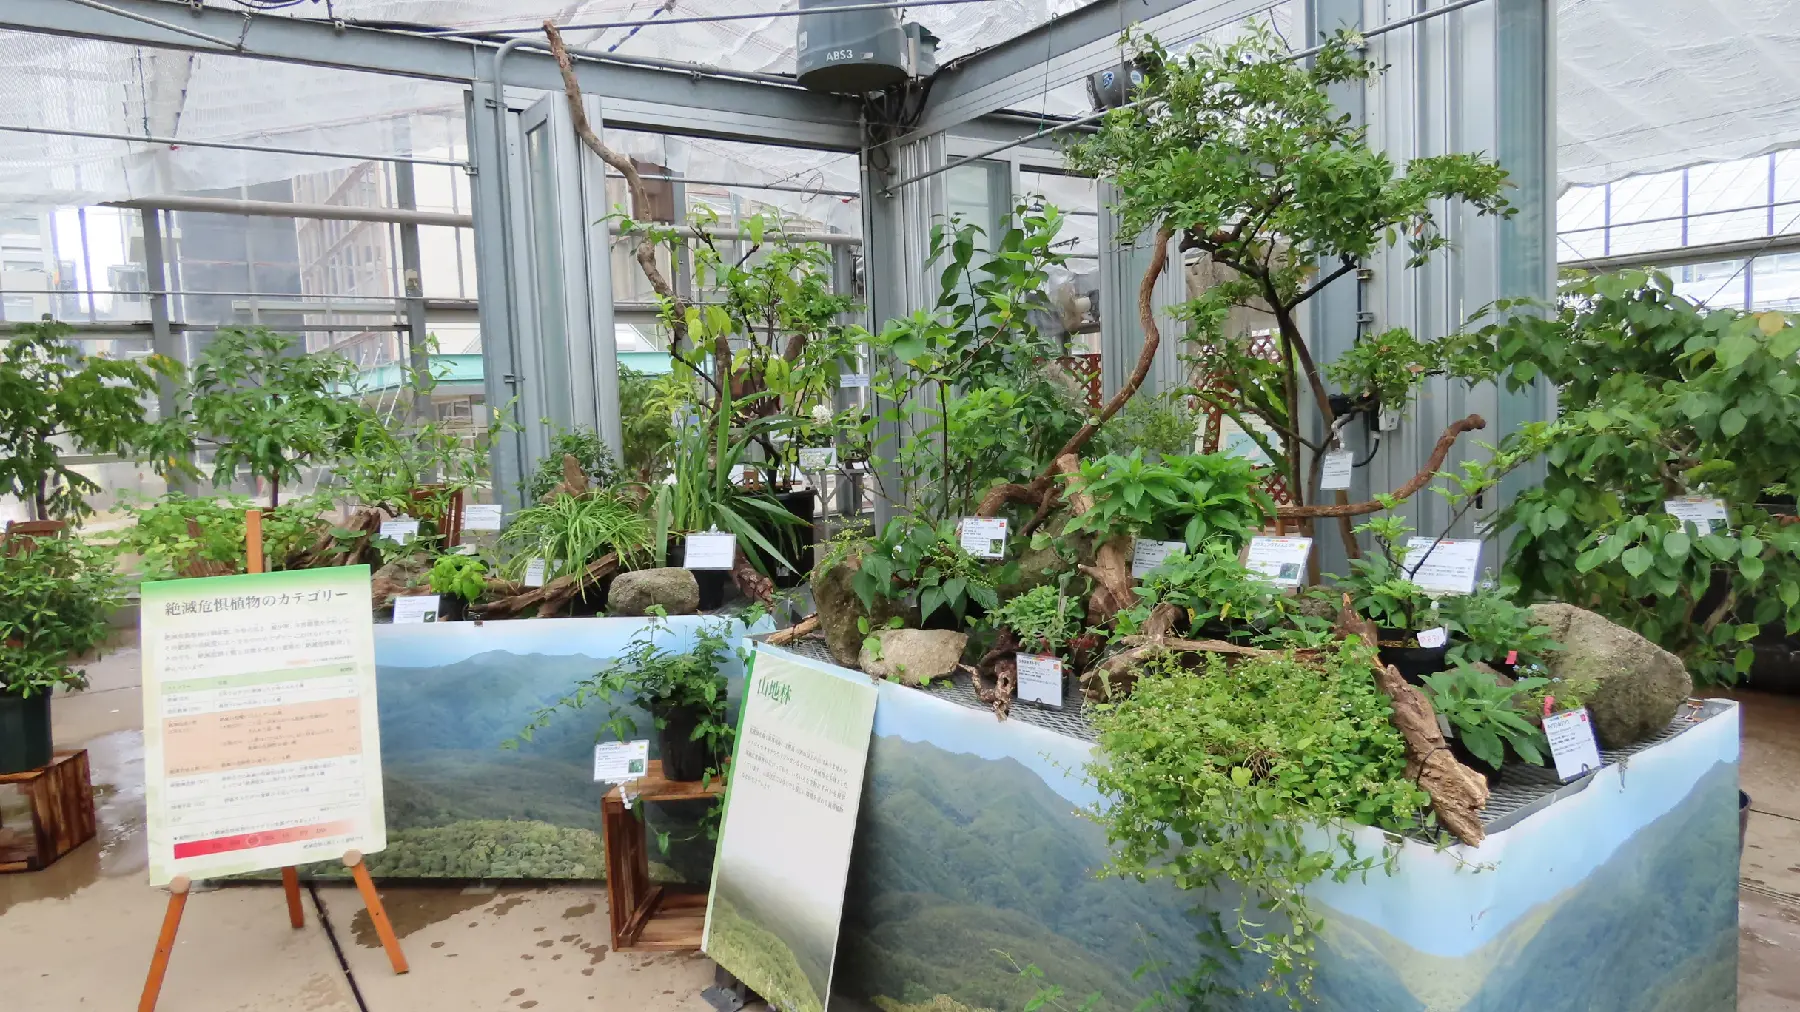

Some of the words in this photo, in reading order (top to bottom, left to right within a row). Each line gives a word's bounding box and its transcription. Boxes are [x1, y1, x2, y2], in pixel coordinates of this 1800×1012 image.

[826, 49, 853, 62] ABS3
[165, 589, 349, 616] 絶滅危惧植物のカテゴリー
[757, 676, 792, 705] 山地林
